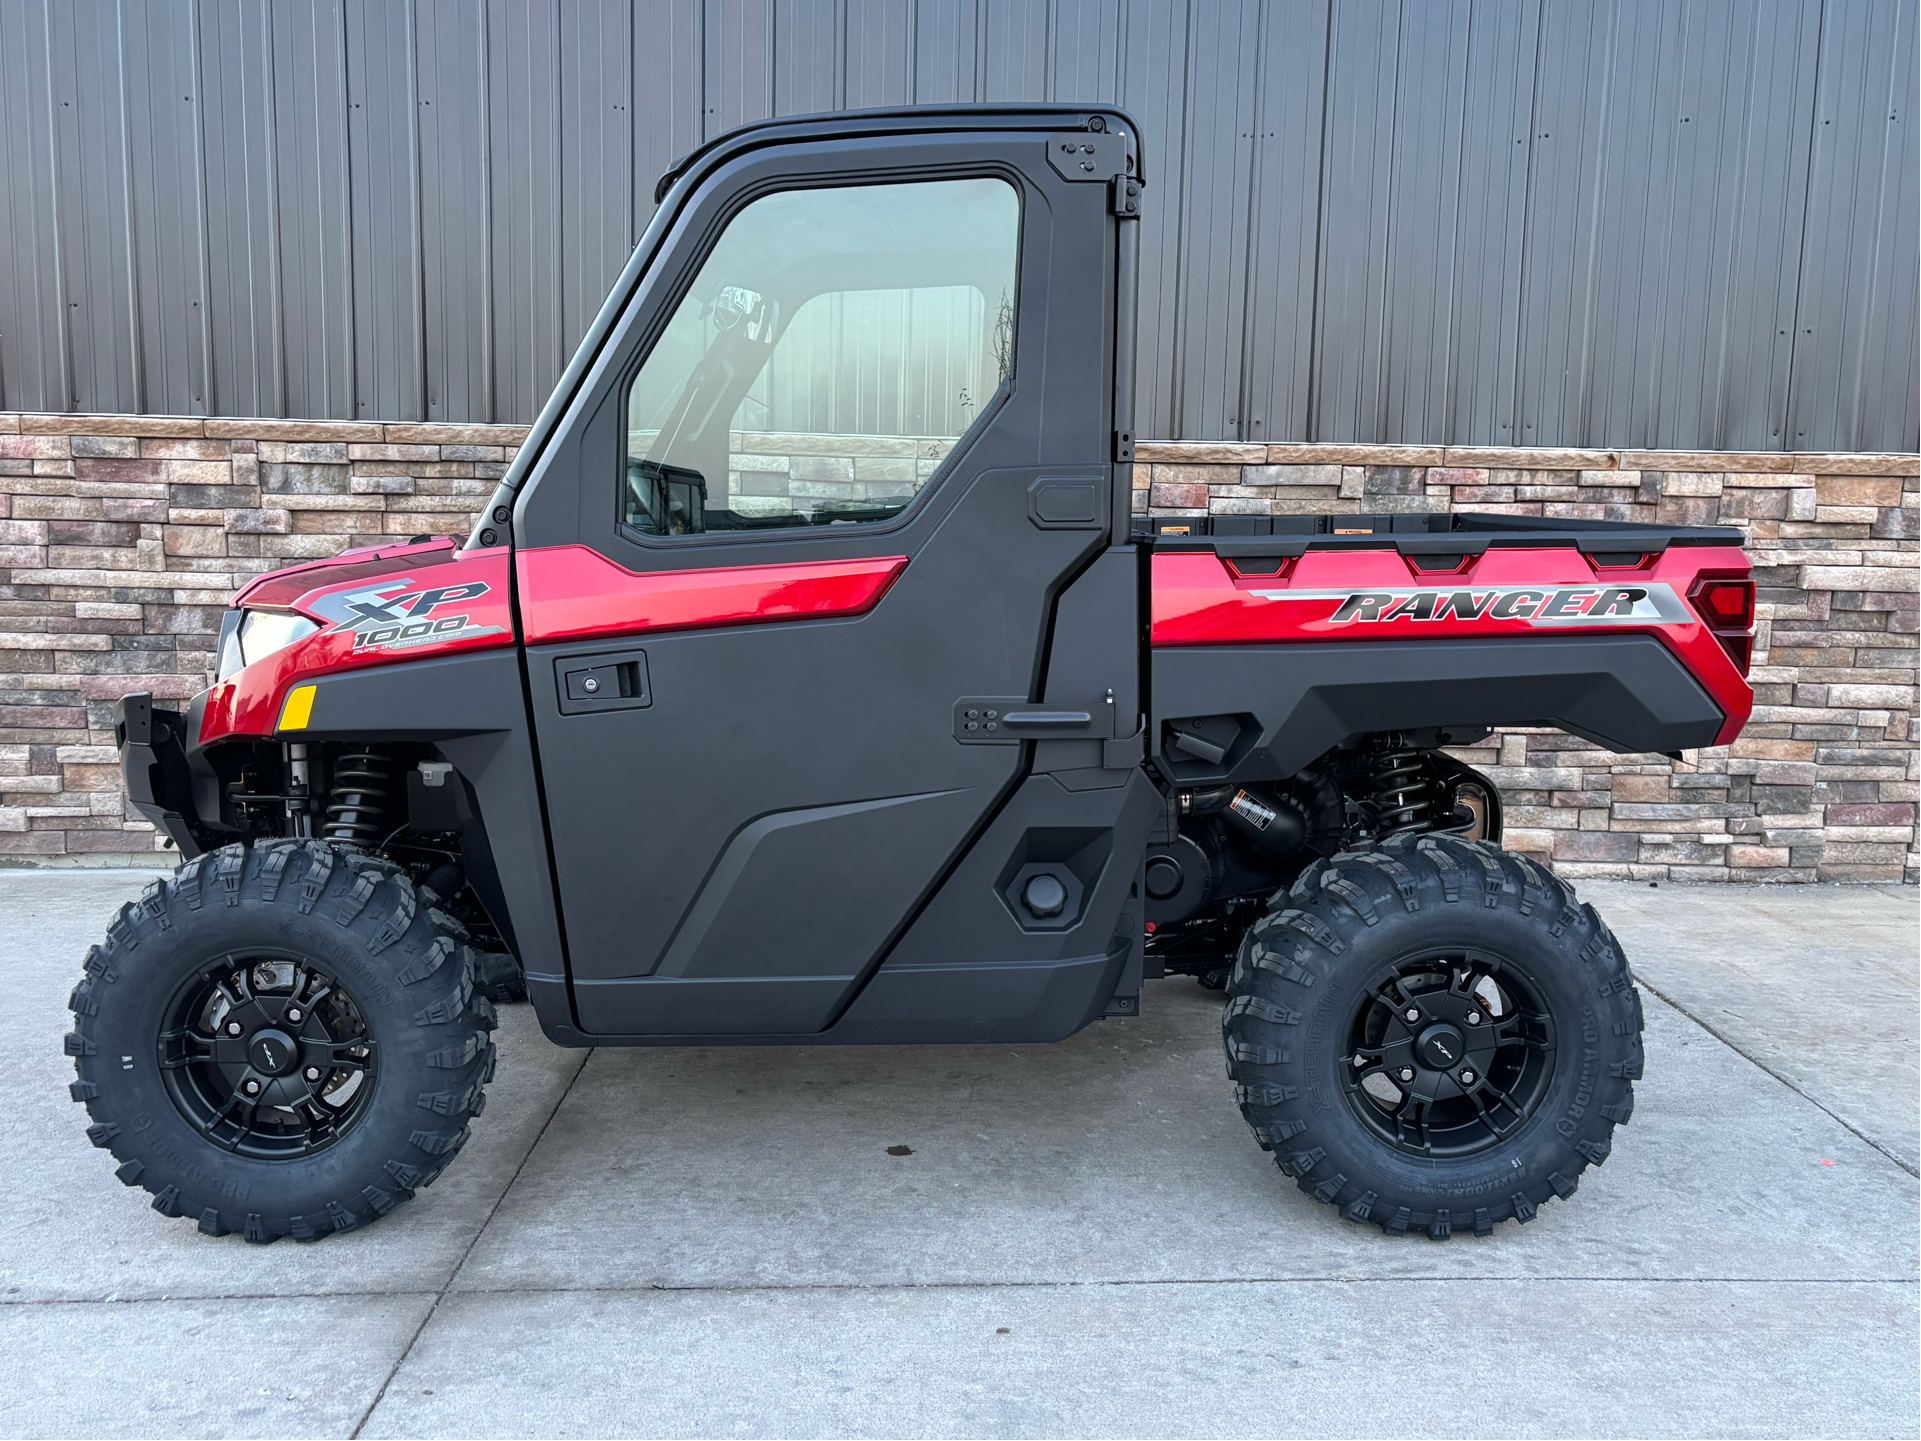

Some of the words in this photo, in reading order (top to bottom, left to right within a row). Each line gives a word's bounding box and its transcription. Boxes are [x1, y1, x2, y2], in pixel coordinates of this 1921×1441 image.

[320, 581, 492, 636] XP
[1329, 587, 1648, 622] RANGER
[352, 615, 469, 649] 1000
[352, 646, 379, 656] DUAL
[381, 635, 437, 650] OVERHEAD
[438, 631, 462, 640] CAM
[278, 920, 393, 1009] X-TERRAIN
[1578, 1003, 1599, 1043] PRO
[262, 1043, 277, 1070] XP
[1304, 982, 1343, 1115] X-TERRAIN
[1432, 1040, 1453, 1060] XP
[1568, 1047, 1599, 1119] ARMOR
